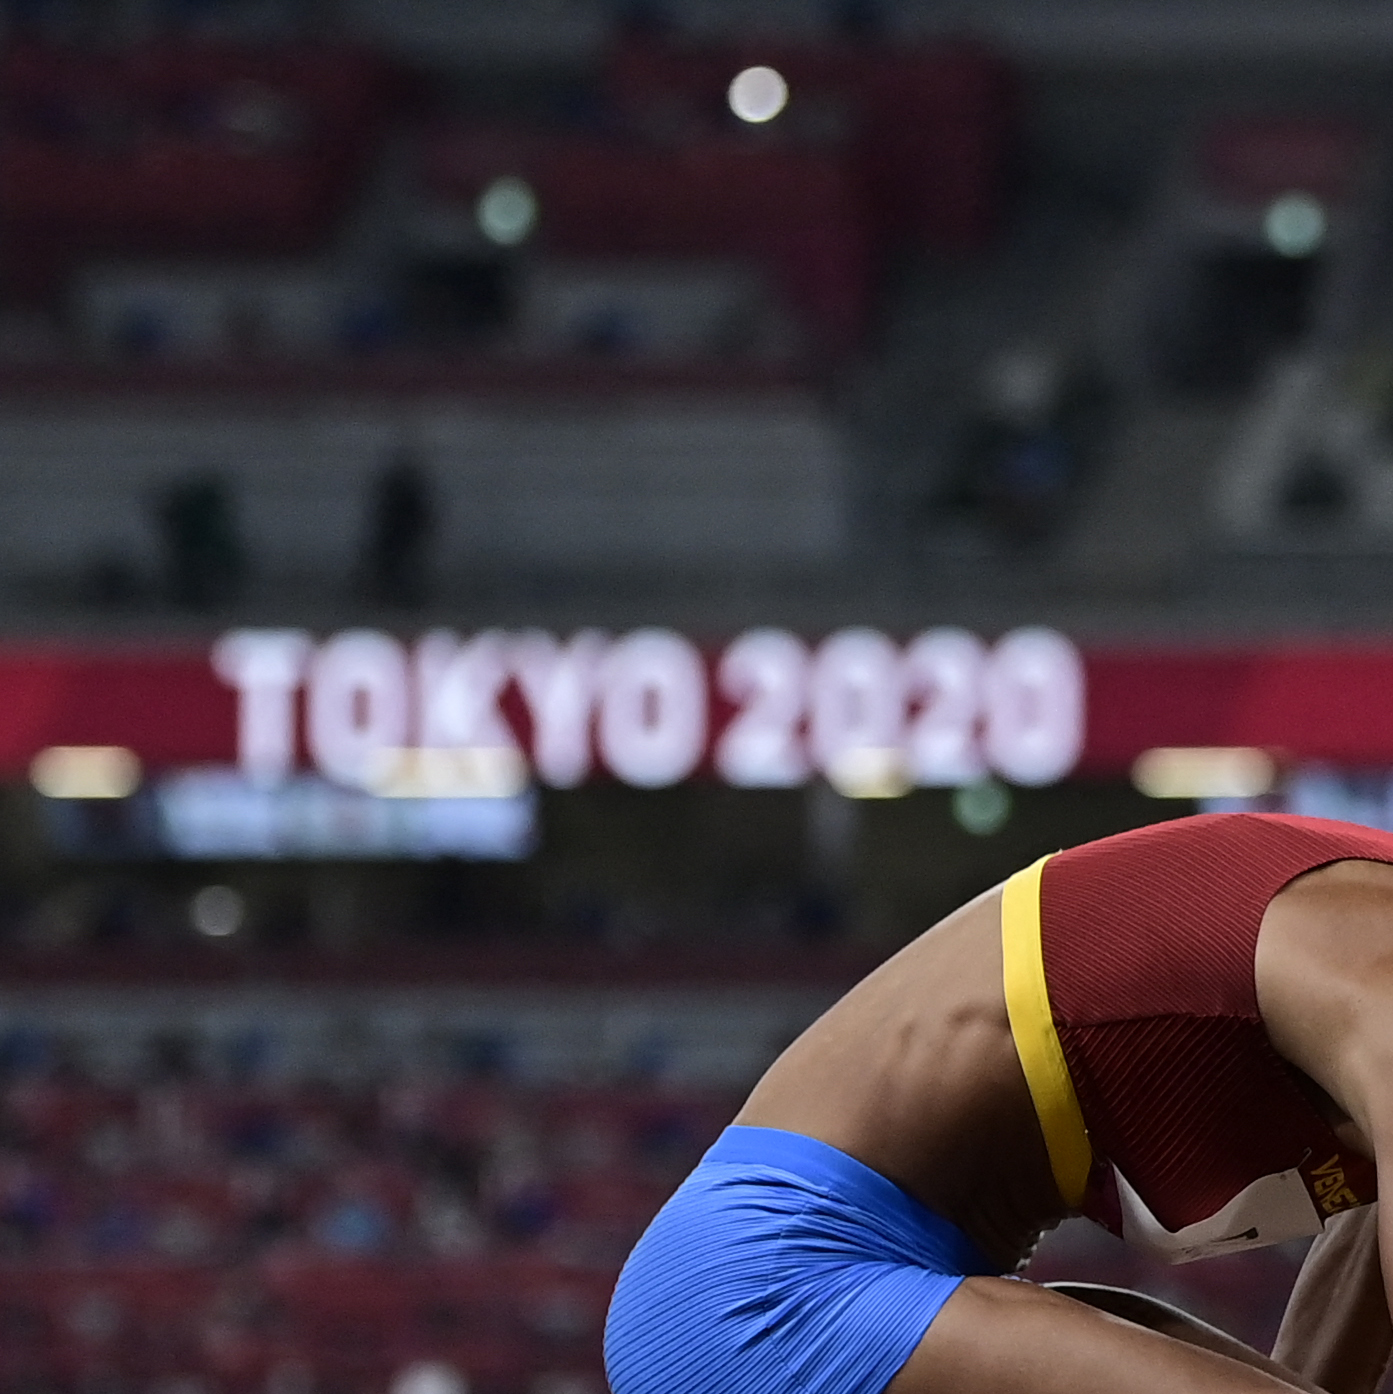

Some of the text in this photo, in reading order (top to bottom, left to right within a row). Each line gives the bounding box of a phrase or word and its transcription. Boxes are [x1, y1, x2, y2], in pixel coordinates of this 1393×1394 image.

[212, 626, 1086, 790] TOKYO 2020
[1310, 1153, 1361, 1213] VENE
